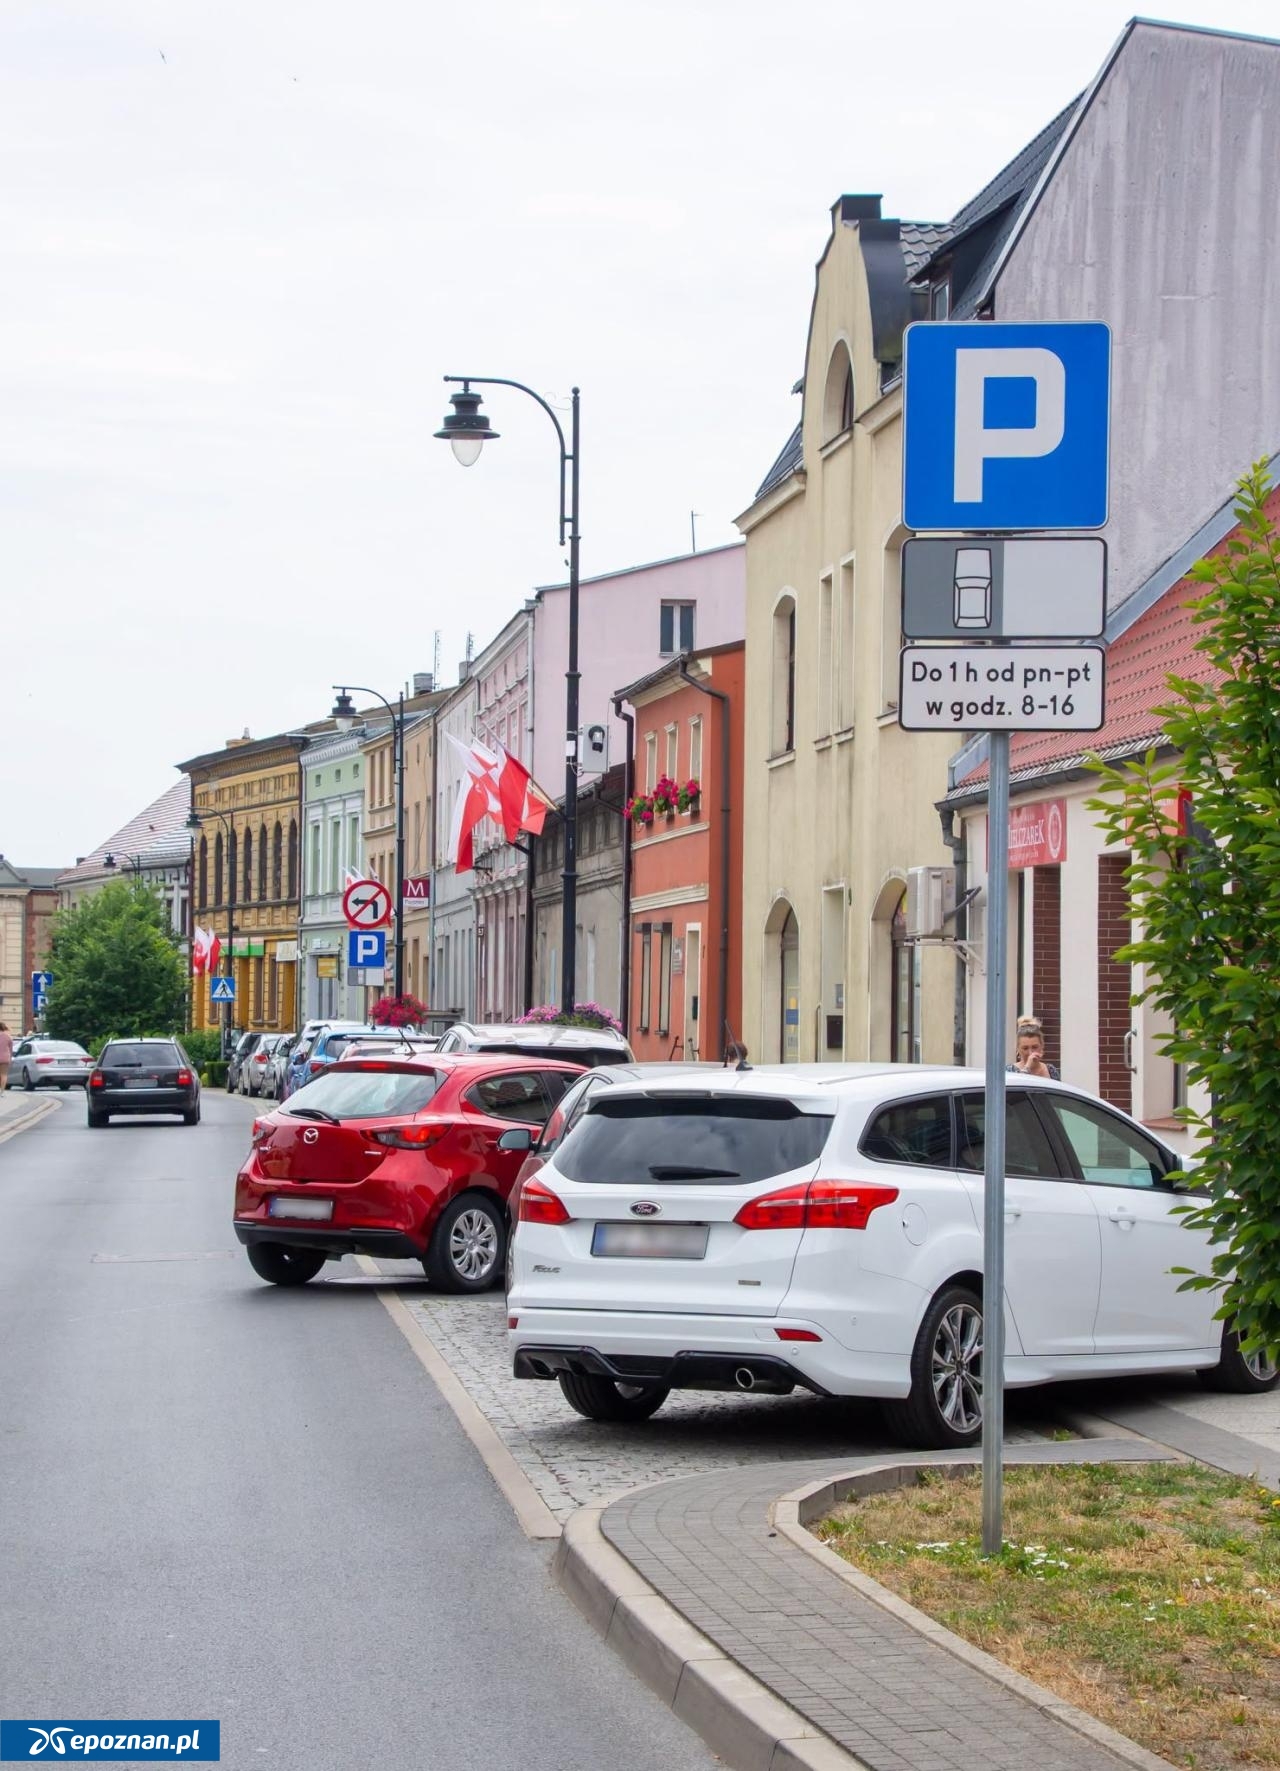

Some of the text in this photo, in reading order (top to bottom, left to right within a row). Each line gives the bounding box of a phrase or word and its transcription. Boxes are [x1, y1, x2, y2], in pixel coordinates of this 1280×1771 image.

[953, 347, 1066, 503] P
[912, 661, 942, 682] Do
[986, 661, 1014, 682] od
[1023, 662, 1091, 688] pn-pt
[926, 694, 1075, 722] w godz. 8-16
[1007, 819, 1045, 849] IELCZAREK
[406, 879, 425, 897] M
[357, 934, 379, 964] P
